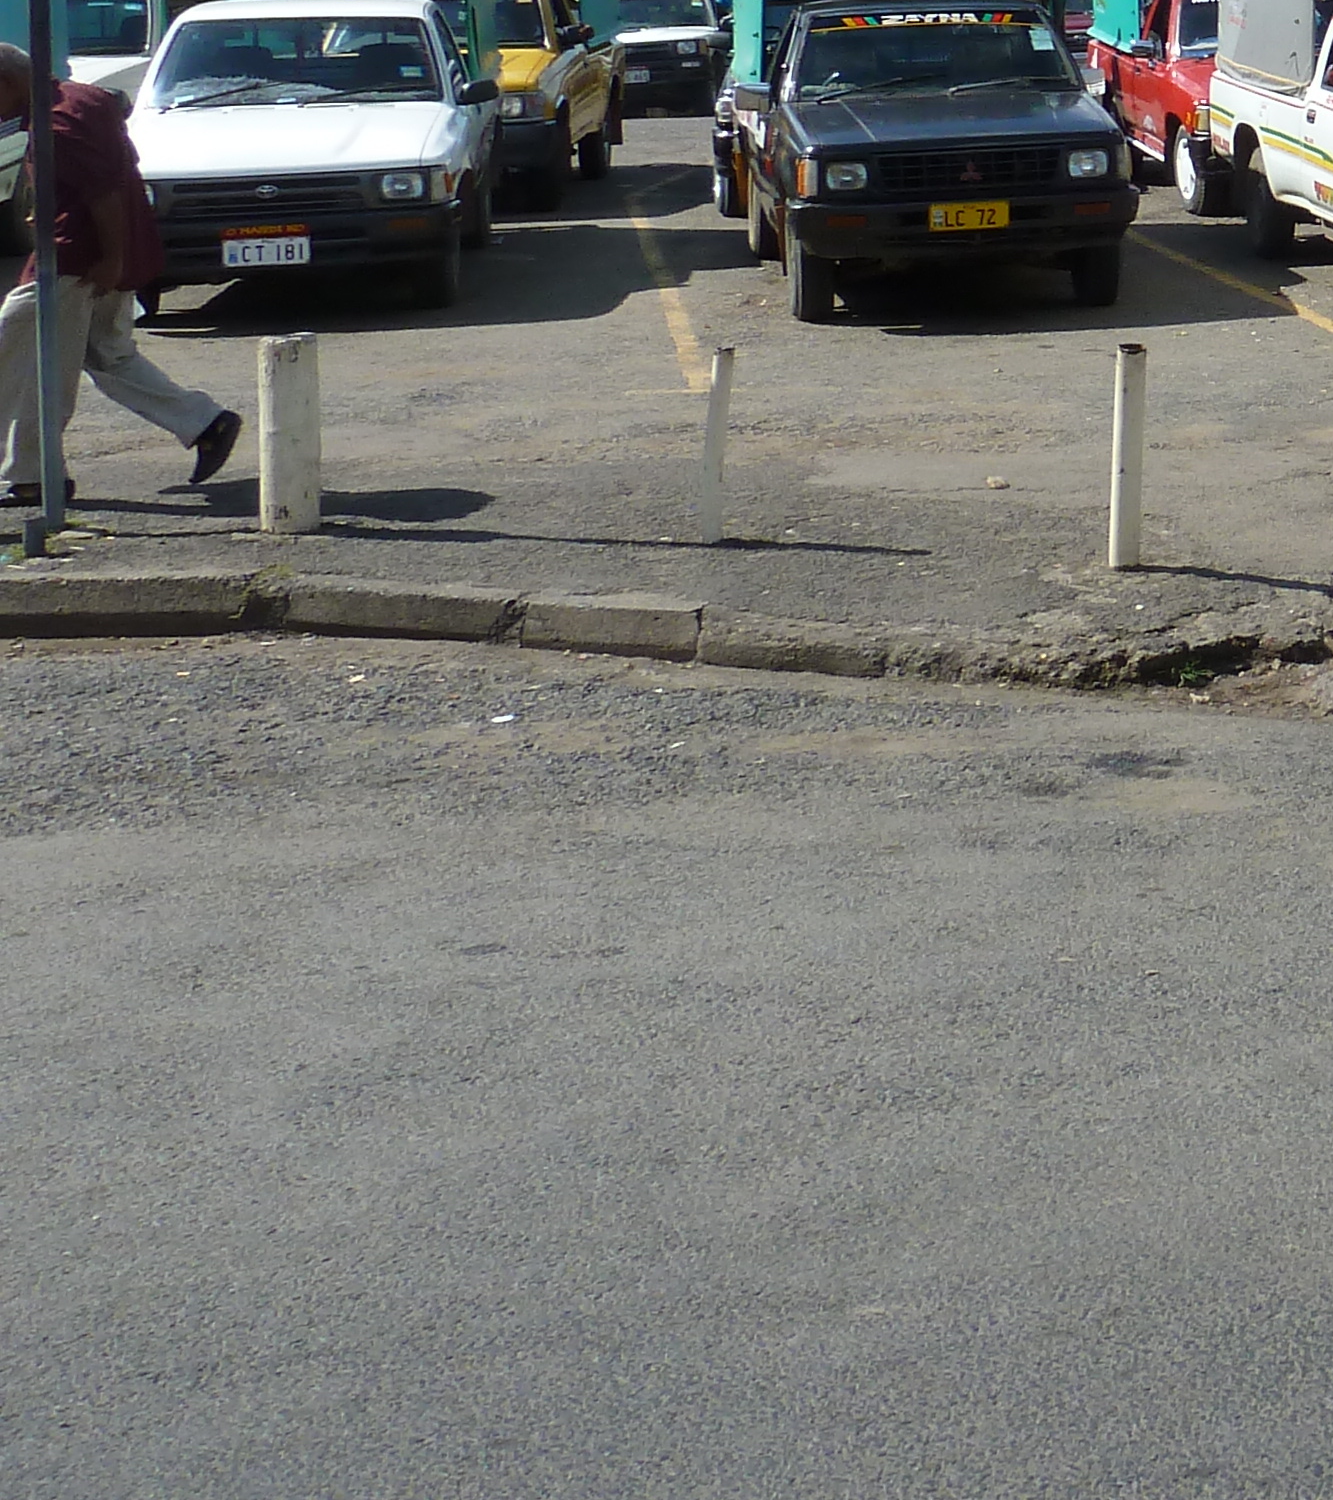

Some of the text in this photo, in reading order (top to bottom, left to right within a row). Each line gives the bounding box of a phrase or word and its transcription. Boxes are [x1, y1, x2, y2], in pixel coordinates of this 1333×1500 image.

[944, 208, 997, 227] LC 72
[242, 243, 304, 263] CT 181
